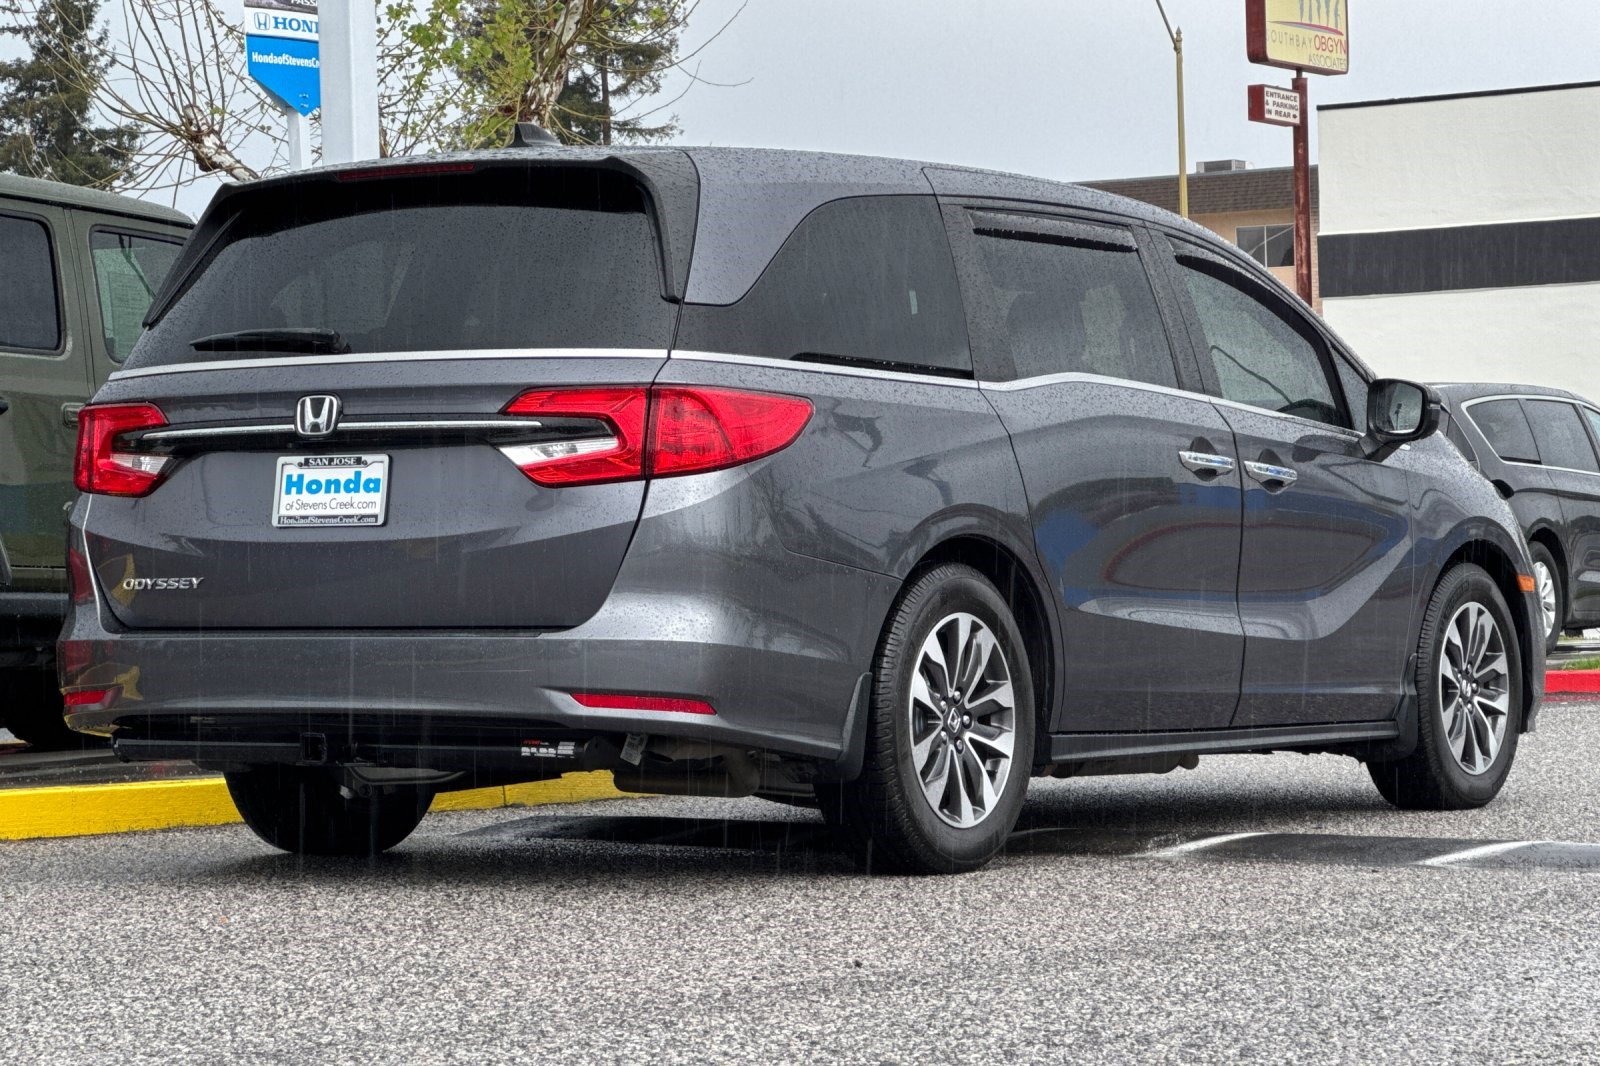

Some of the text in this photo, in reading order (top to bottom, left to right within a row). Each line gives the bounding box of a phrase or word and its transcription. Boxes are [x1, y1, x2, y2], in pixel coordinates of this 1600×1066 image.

[1266, 30, 1346, 55] OUTHBAY OBGYN
[251, 51, 319, 68] HondaofStevensCr
[1265, 90, 1298, 102] ENTRANCE
[1272, 100, 1299, 111] PARKING
[1274, 110, 1292, 119] REAR
[308, 457, 358, 466] SAN JOSE
[285, 470, 381, 495] Honda
[285, 496, 377, 511] of Stevens Creek.com
[123, 577, 204, 590] ODYSSEY
